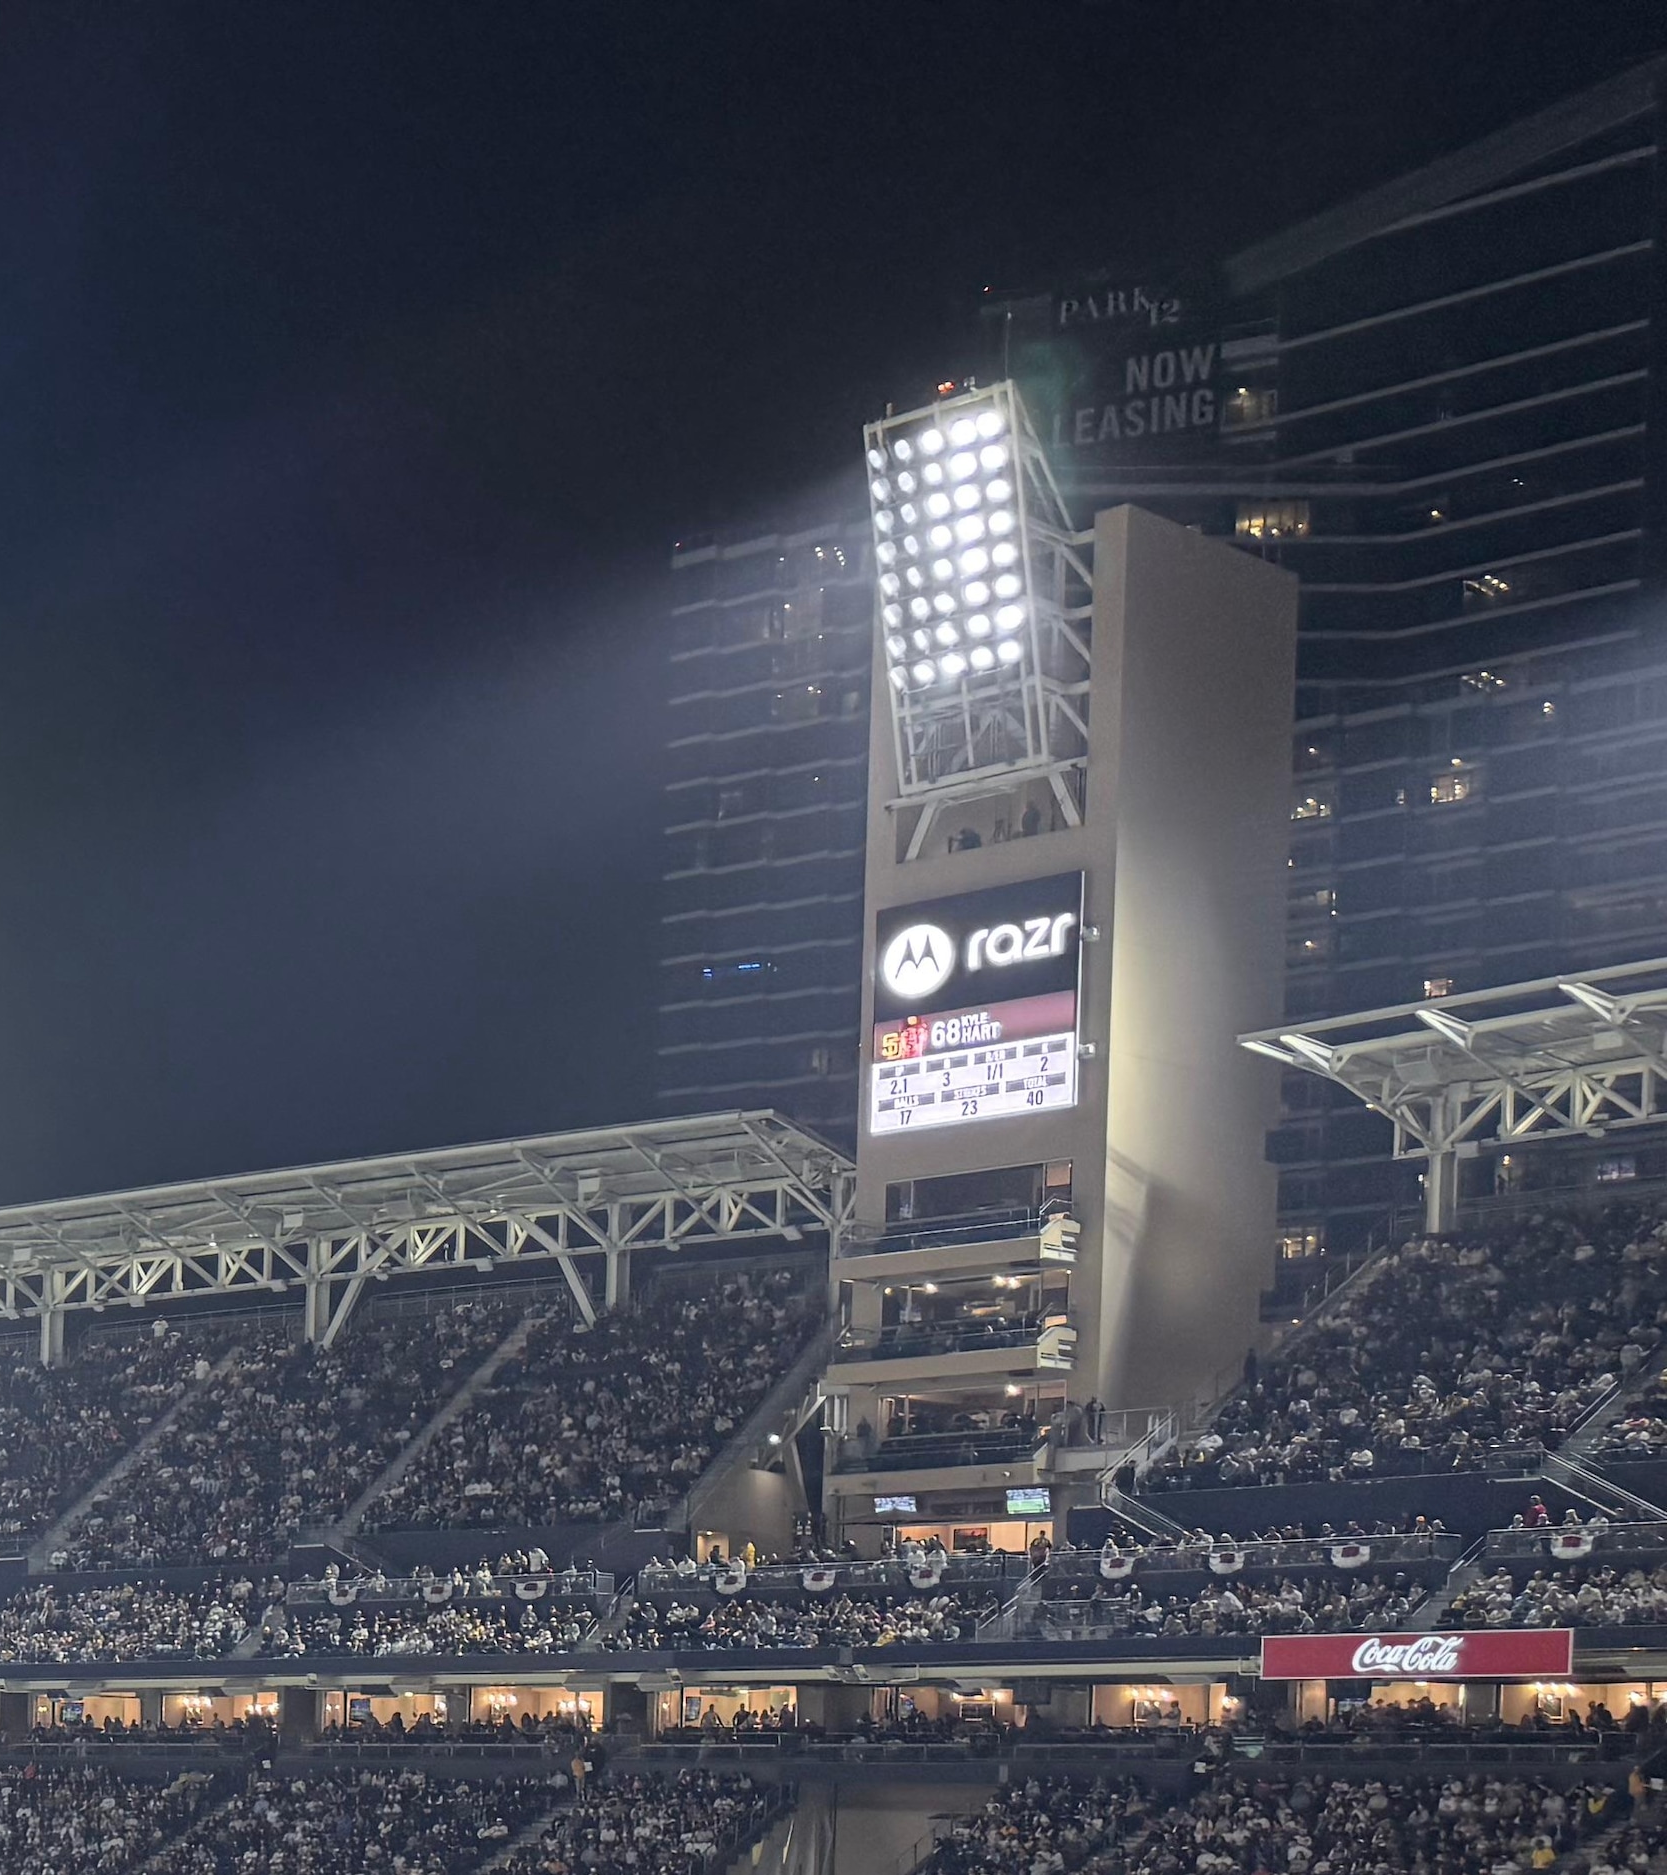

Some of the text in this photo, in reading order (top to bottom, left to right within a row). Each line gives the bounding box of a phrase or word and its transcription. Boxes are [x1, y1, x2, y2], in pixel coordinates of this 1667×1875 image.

[1126, 344, 1216, 394] NOW
[1053, 388, 1216, 448] LEASING
[967, 911, 1076, 971] razr
[931, 1019, 961, 1047] 68
[962, 1023, 1001, 1043] HART
[891, 1056, 1048, 1095] 2.1 3 1/1 2
[900, 1090, 1044, 1125] 17 23 40
[1352, 1637, 1465, 1672] Coca-Cola
